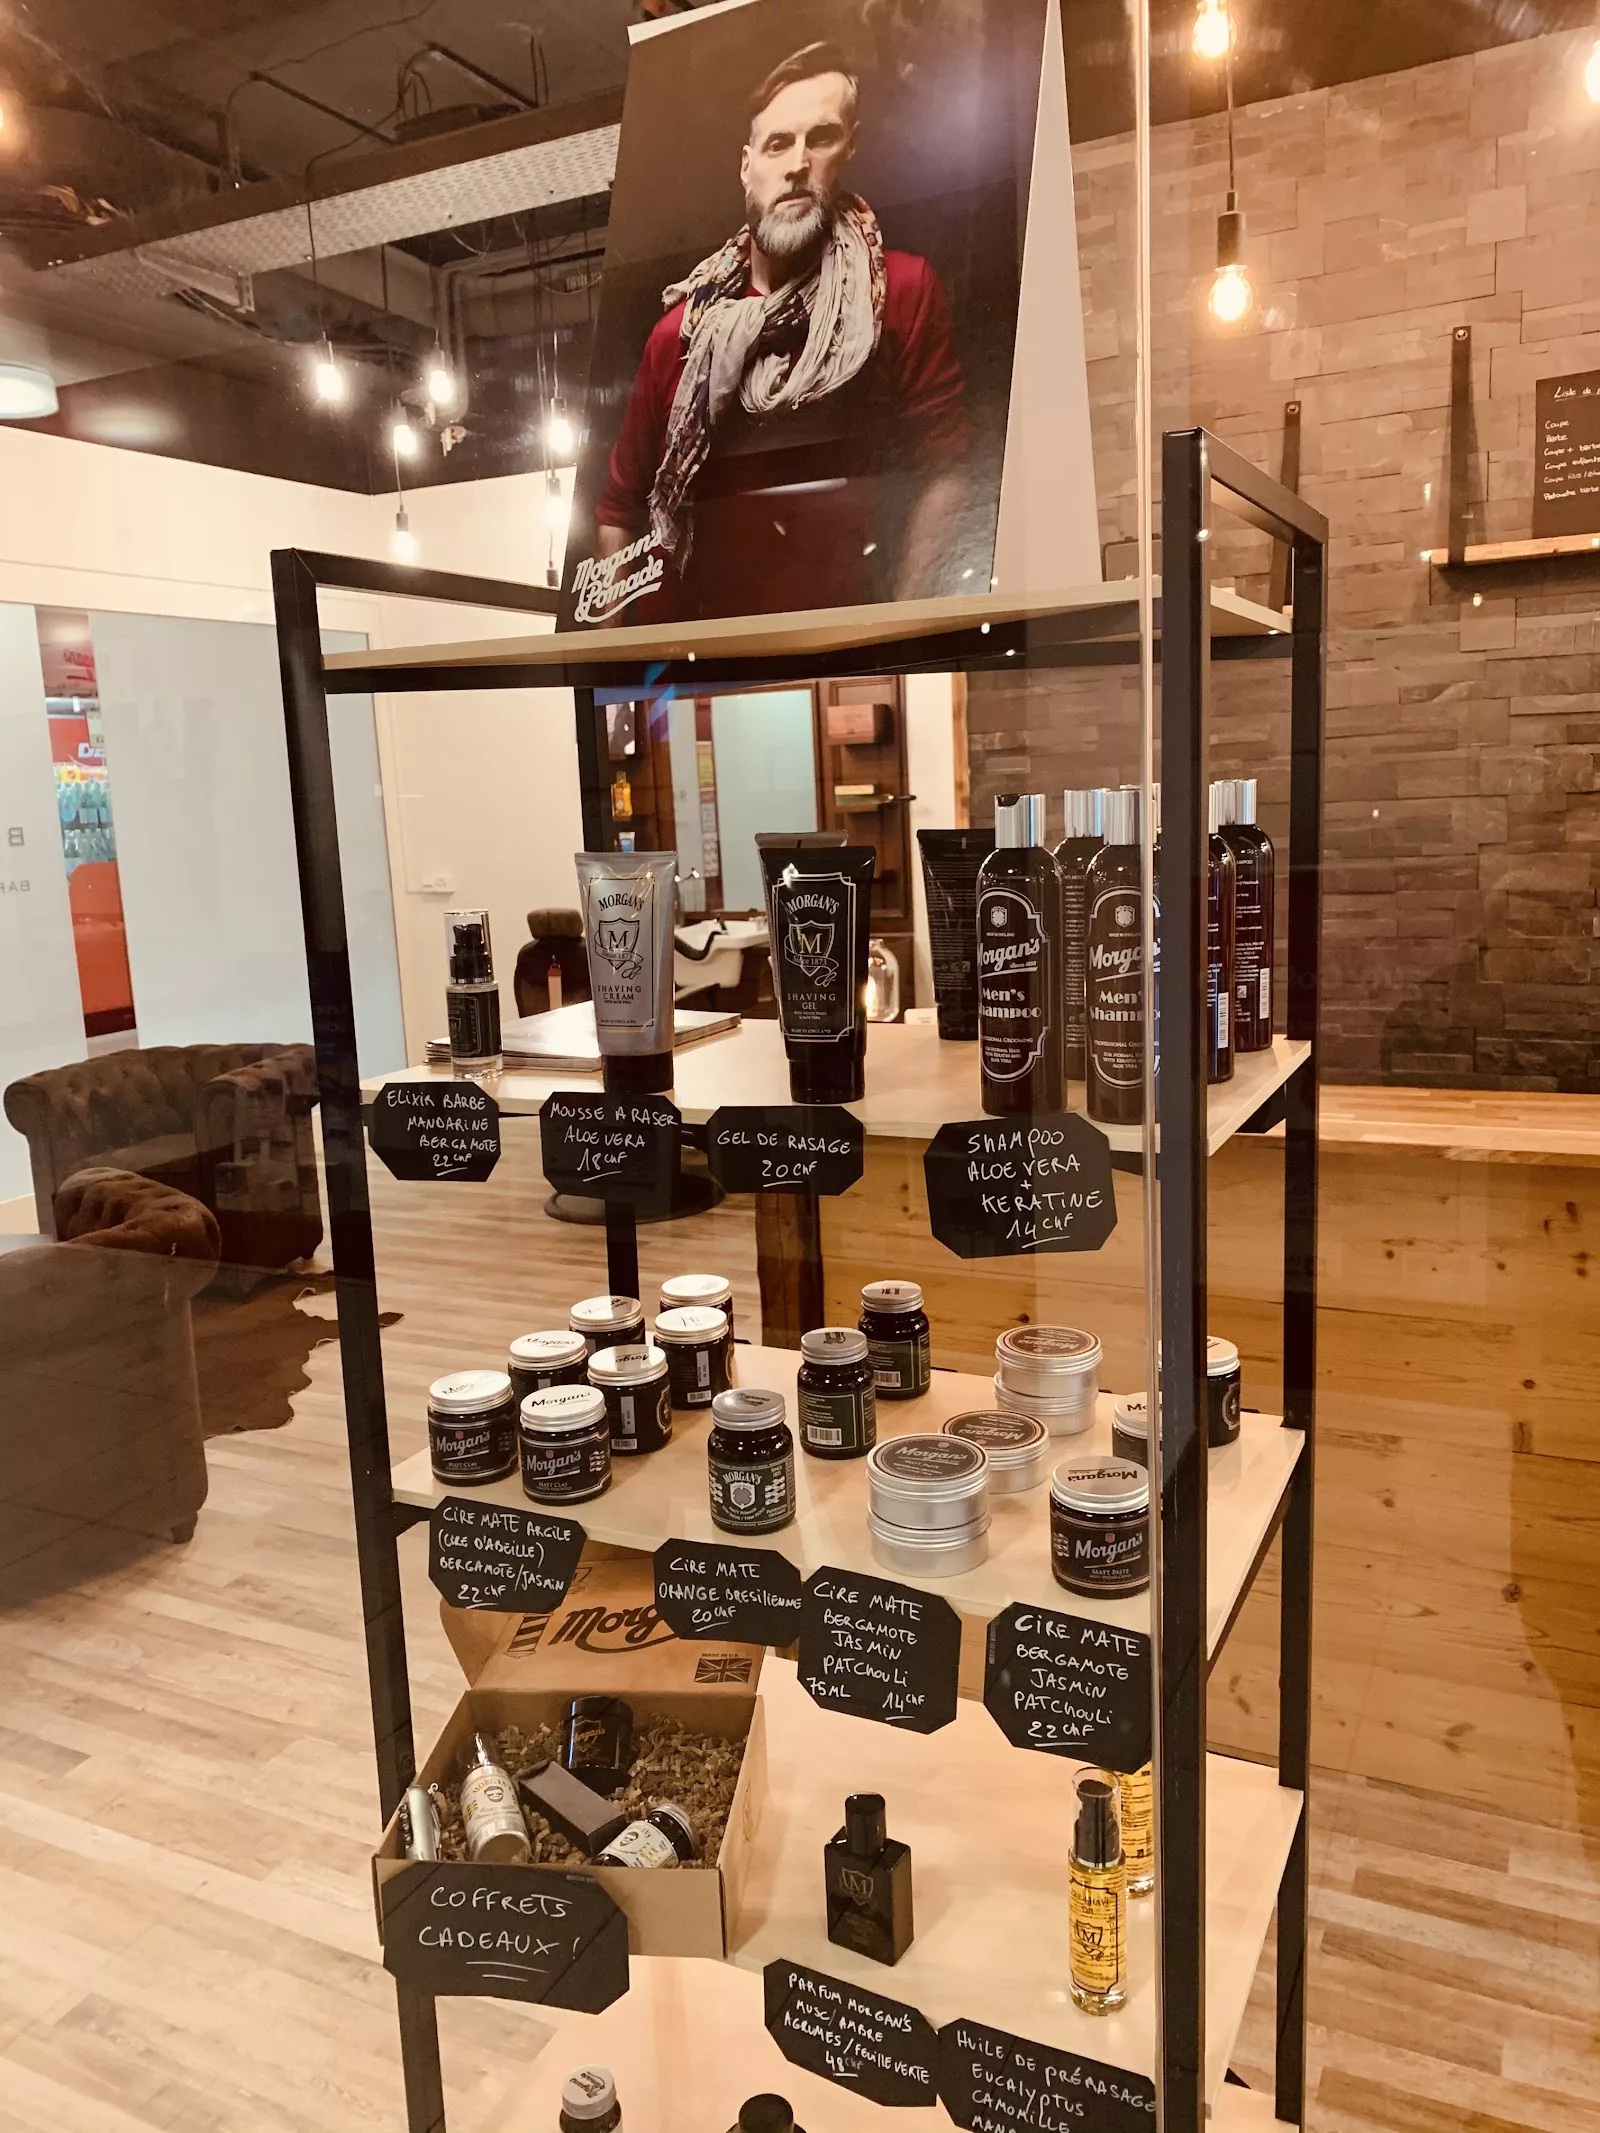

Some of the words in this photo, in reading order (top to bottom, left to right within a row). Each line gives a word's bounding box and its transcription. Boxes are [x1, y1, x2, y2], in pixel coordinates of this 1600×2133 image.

[1545, 420, 1569, 429] Coupe
[1544, 448, 1565, 456] Coupe
[1545, 462, 1568, 470] Coupe
[571, 527, 662, 594] Morgan's
[585, 554, 664, 618] Pomade
[599, 893, 645, 912] MORGAN'S
[786, 893, 840, 915] MORGAN'S
[799, 933, 822, 954] M
[597, 985, 642, 993] SHAVING
[603, 993, 634, 1001] CREAM
[787, 993, 836, 1002] SHAVING
[802, 1002, 817, 1010] GEL
[443, 1092, 486, 1110] BARBE
[550, 1102, 604, 1120] MOUSSE
[631, 1107, 678, 1126] RASER
[419, 1135, 497, 1152] BERGAMOTE
[564, 1126, 599, 1144] ALOE
[605, 1132, 646, 1148] VERA
[717, 1130, 750, 1145] GEL
[757, 1132, 778, 1146] DE
[788, 1135, 850, 1154] RASAGE
[968, 1161, 1016, 1182] ALOE
[1022, 1154, 1080, 1176] VERA
[1020, 1180, 1032, 1190] +
[436, 1431, 490, 1456] Morgan's
[896, 1445, 968, 1461] Morgan's
[526, 1450, 581, 1476] Morgan's
[722, 1471, 763, 1485] MORGAN'S
[480, 1513, 520, 1532] MATE
[1075, 1532, 1143, 1563] Morgan's
[716, 1563, 760, 1579] MATE
[659, 1582, 720, 1602] ORANGE
[869, 1595, 923, 1621] MATE
[548, 1604, 657, 1646] Morg
[824, 1608, 918, 1646] BERGAMOTE
[1080, 1628, 1140, 1657] MATE
[1016, 1644, 1129, 1681] BERGAMOTE
[430, 1886, 573, 1918] COFFRETS
[418, 1926, 560, 1956] CADEAUX
[788, 1972, 842, 2004] PARFUM
[848, 1998, 912, 2032] MORGAN'S
[839, 2016, 884, 2043] AMBRE
[894, 2061, 930, 2084] VERTE
[1015, 2053, 1036, 2071] DE
